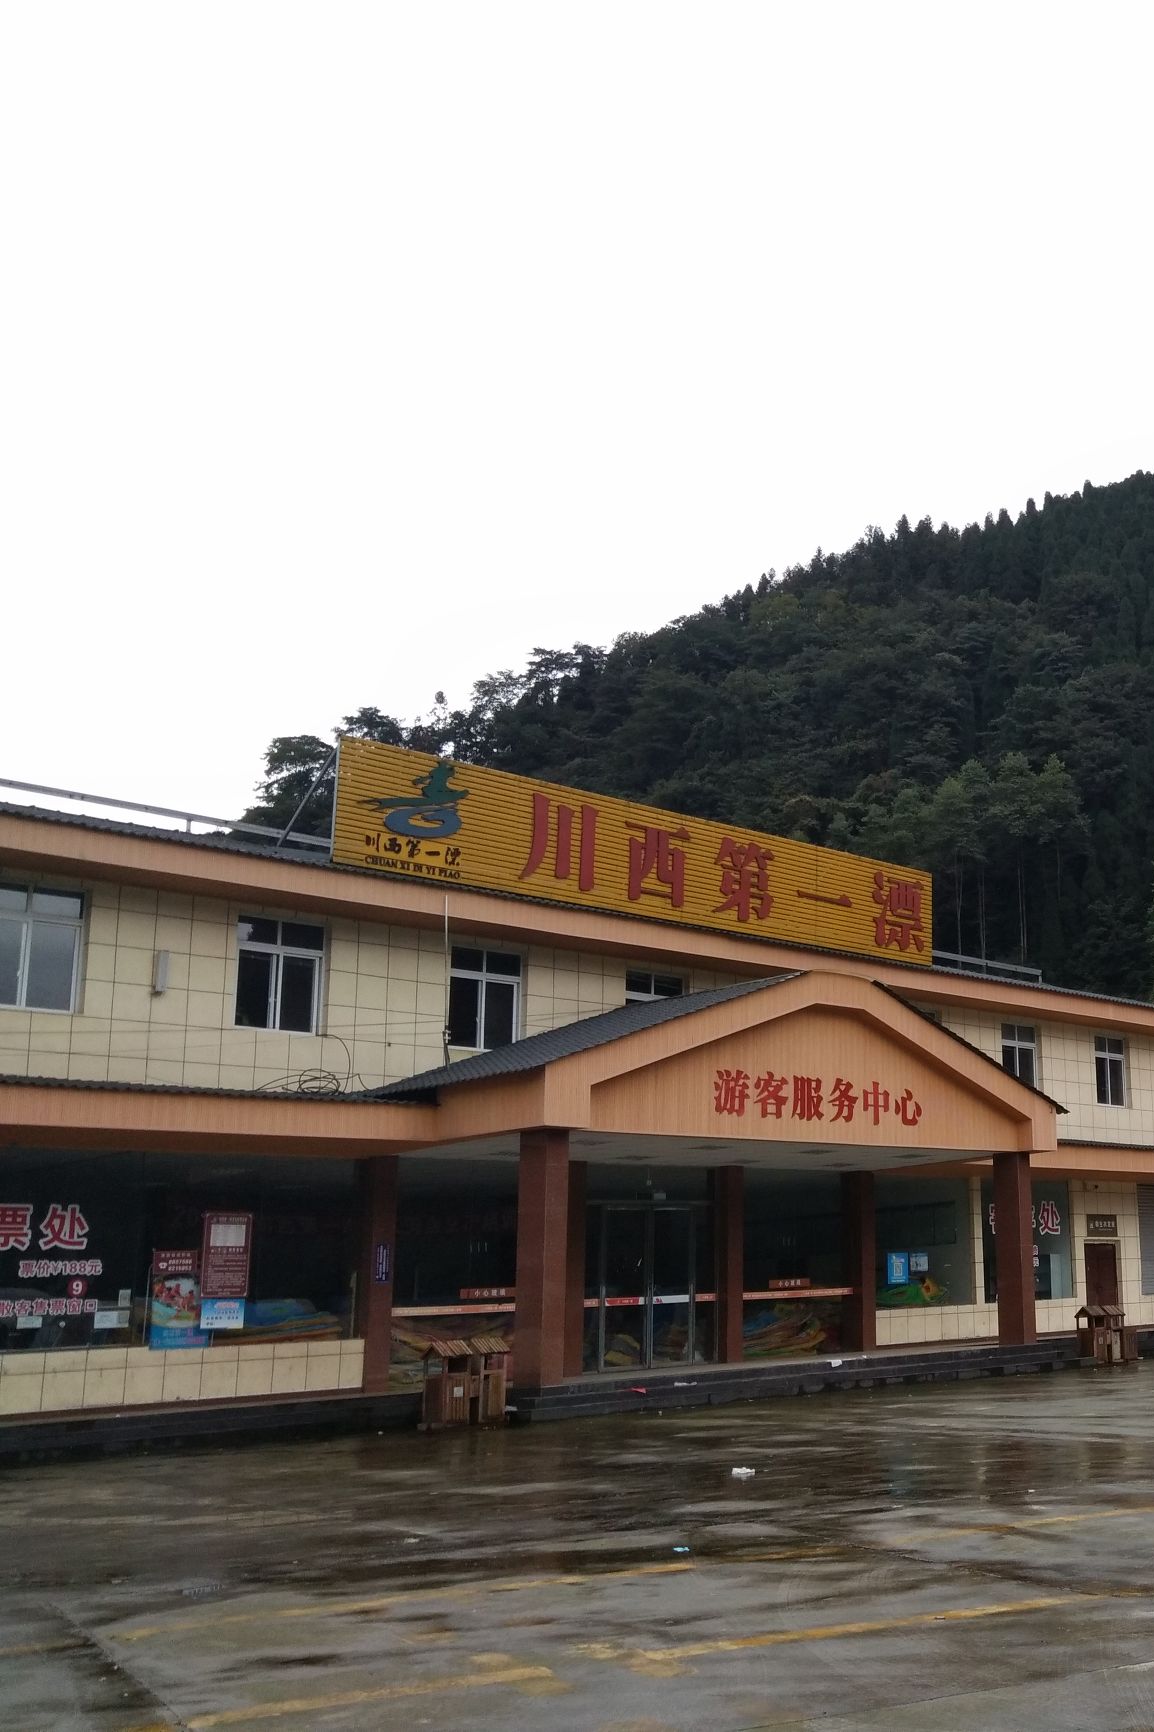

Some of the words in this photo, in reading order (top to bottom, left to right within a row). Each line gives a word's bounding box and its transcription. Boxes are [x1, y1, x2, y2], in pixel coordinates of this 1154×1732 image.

[519, 792, 925, 953] 川西第一漂
[714, 1069, 923, 1126] 游客服务中心
[72, 1281, 83, 1295] 9
